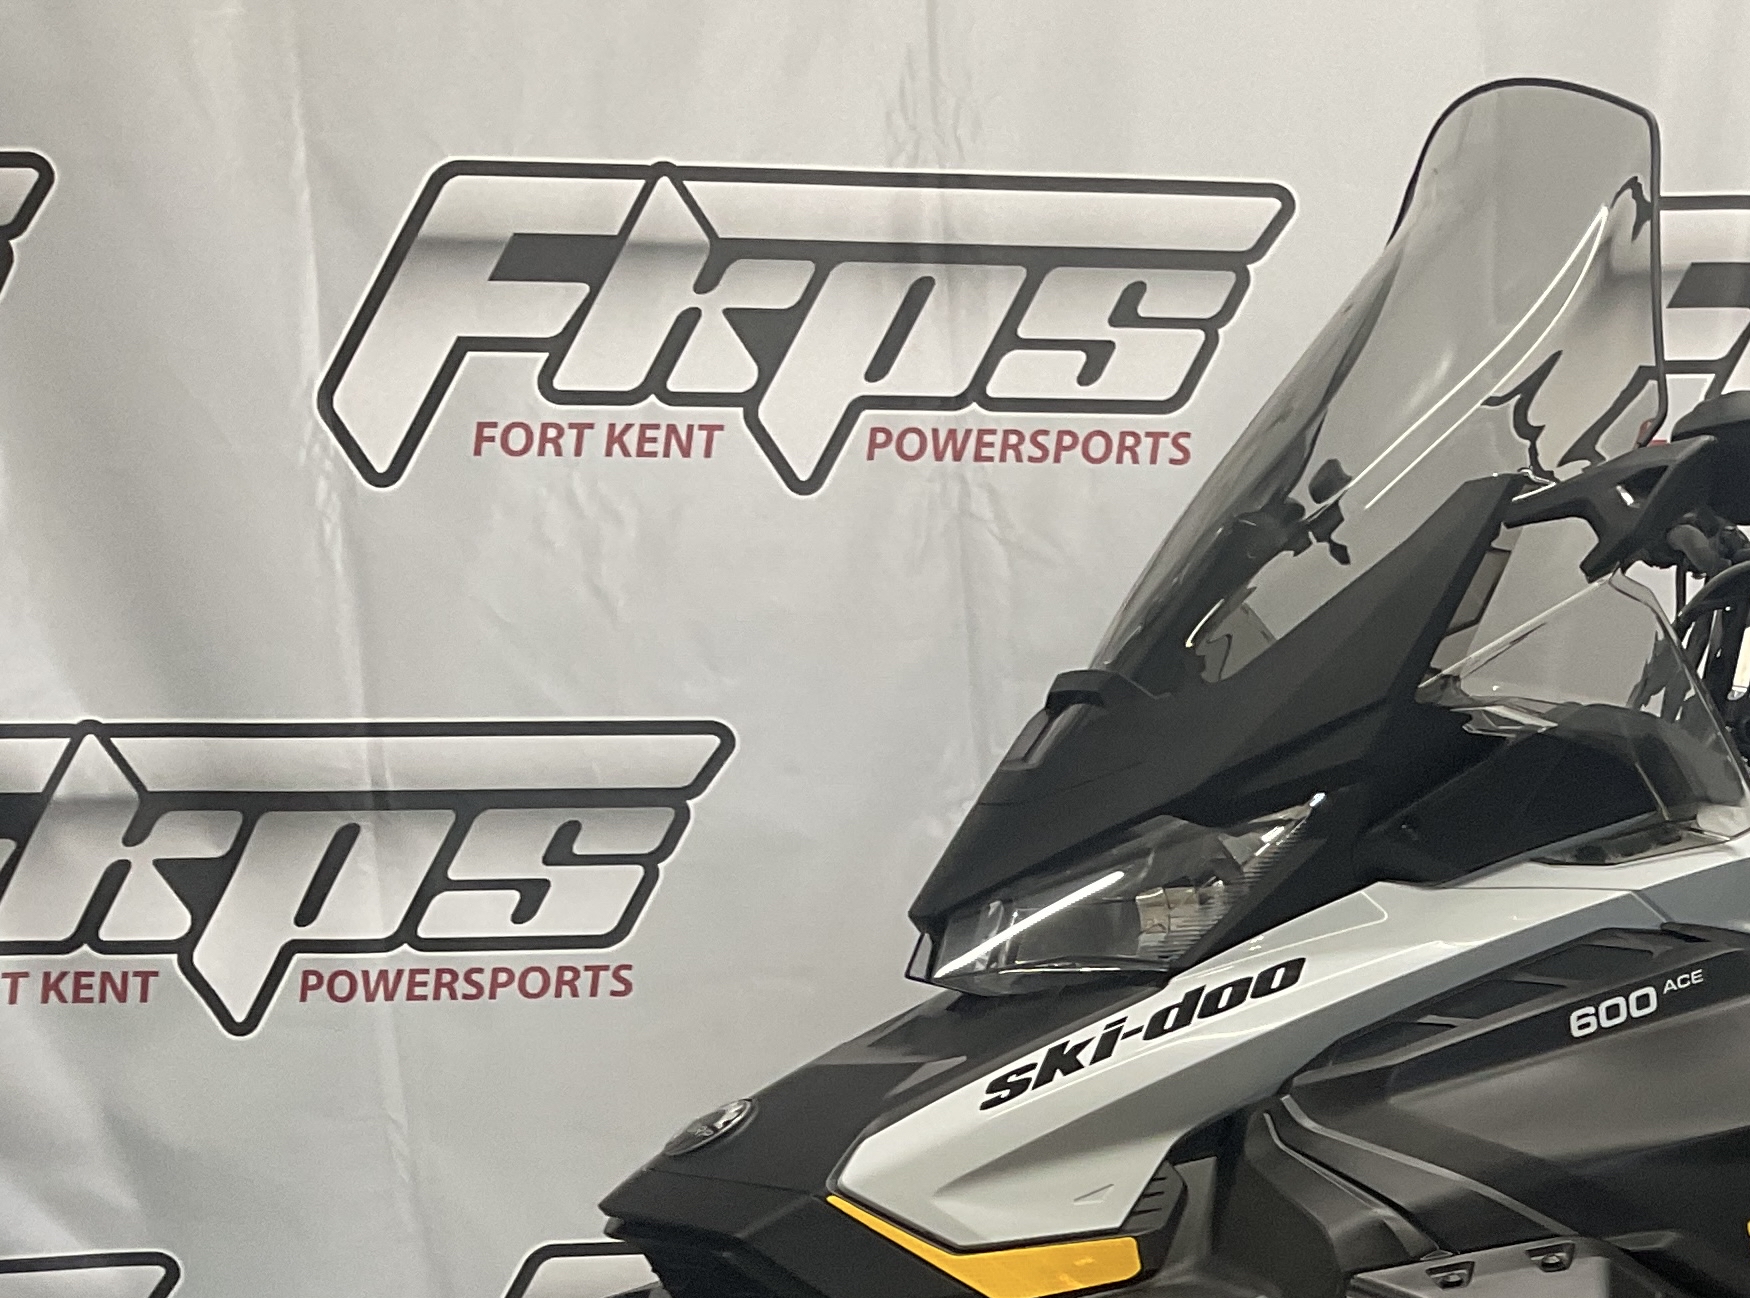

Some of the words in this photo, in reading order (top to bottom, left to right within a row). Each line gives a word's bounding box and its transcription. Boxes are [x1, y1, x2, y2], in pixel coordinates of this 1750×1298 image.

[472, 421, 595, 458] FORT
[604, 422, 726, 459] KENT
[865, 426, 1192, 466] POWERSPORTS
[40, 970, 160, 1004] KENT
[298, 963, 635, 1004] POWERSPORTS
[1569, 985, 1658, 1038] 600
[1662, 968, 1704, 995] ACE
